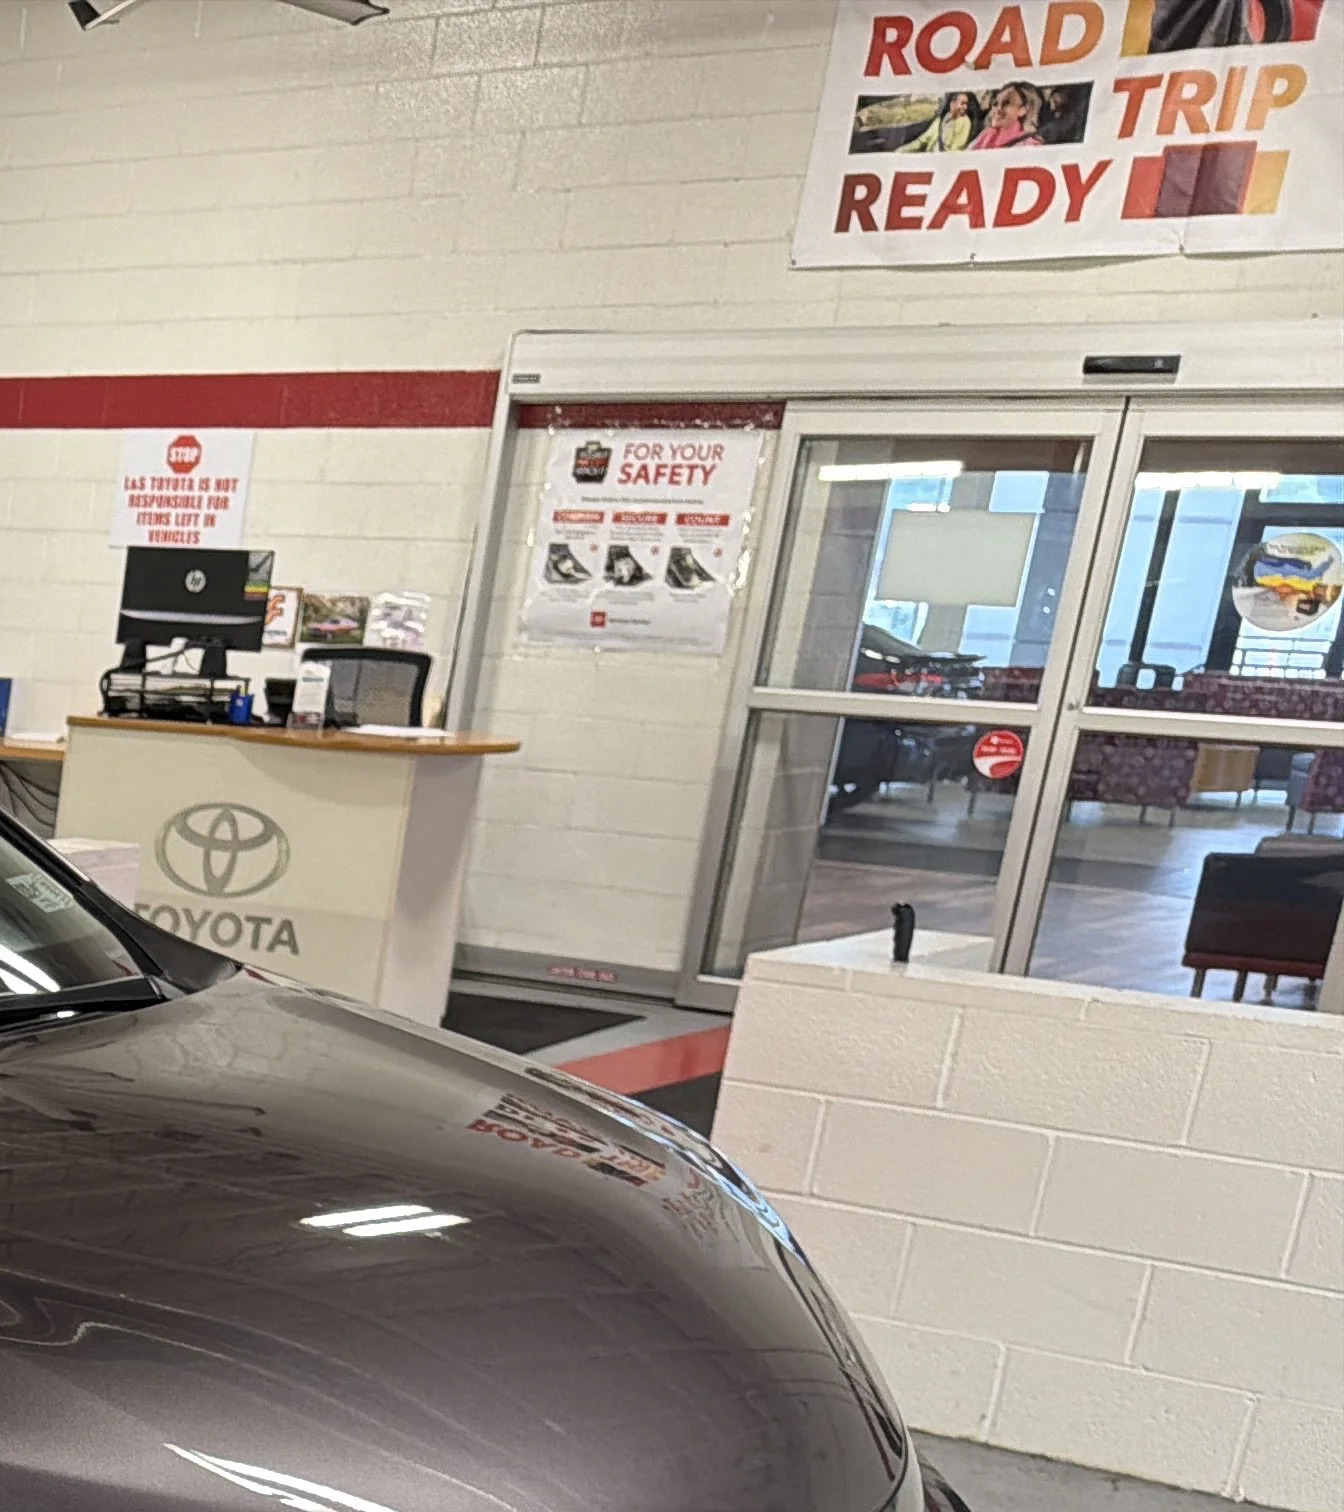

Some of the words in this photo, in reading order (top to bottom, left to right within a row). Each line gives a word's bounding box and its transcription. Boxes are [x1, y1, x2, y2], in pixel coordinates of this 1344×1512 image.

[863, 2, 1105, 77] ROAD
[1112, 63, 1308, 139] TRIP
[834, 158, 1114, 233] READY
[169, 446, 199, 463] STOP
[623, 442, 665, 461] FOR
[669, 443, 725, 463] YOUR
[617, 463, 717, 486] SAFETY
[150, 476, 194, 492] TOYOTA
[198, 478, 210, 492] IS
[214, 478, 239, 493] NOT
[127, 494, 203, 509] RESPONSIBLE
[207, 496, 231, 510] FOR
[136, 511, 171, 526] ITEMS
[175, 513, 200, 527] LEFT
[203, 513, 217, 528] IN
[147, 529, 201, 544] VEHICLES
